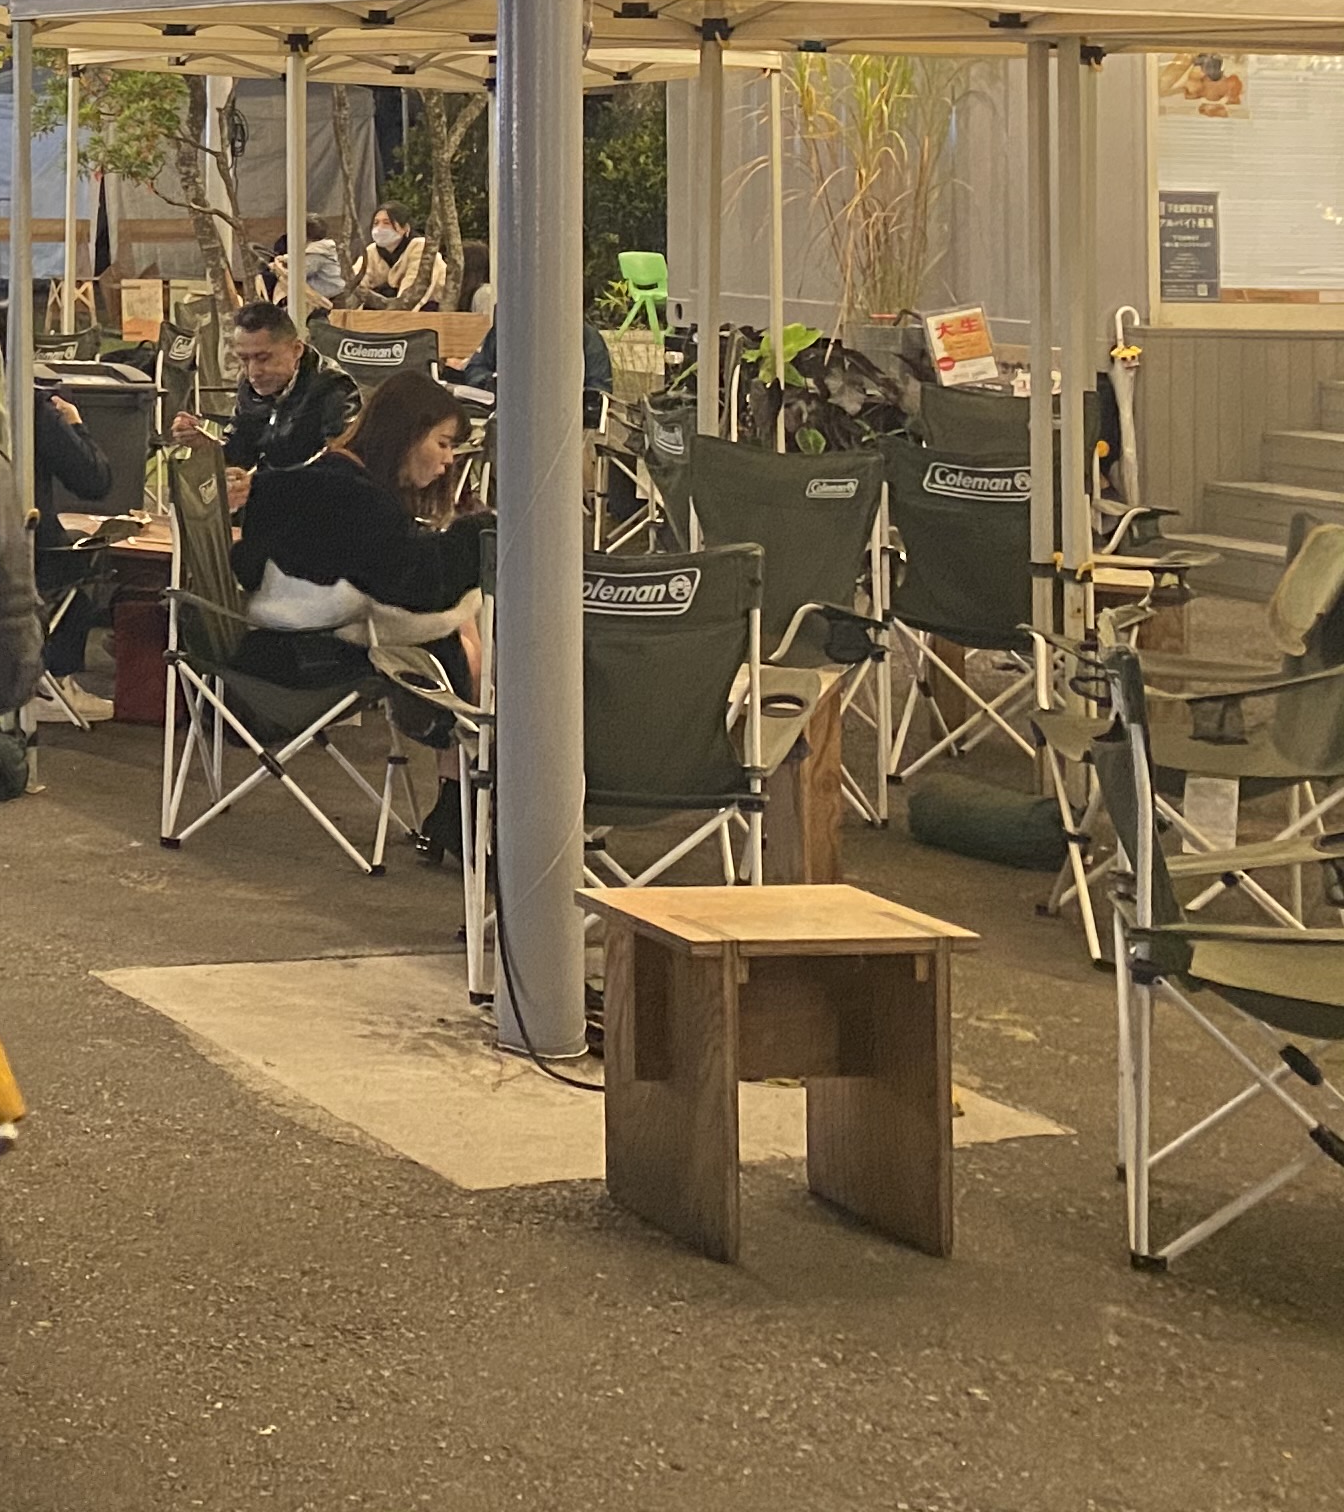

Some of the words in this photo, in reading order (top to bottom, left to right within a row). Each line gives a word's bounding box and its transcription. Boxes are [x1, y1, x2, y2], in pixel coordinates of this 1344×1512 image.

[343, 342, 392, 358] Coleman
[934, 467, 1013, 491] Coleman
[583, 577, 667, 603] oleman
